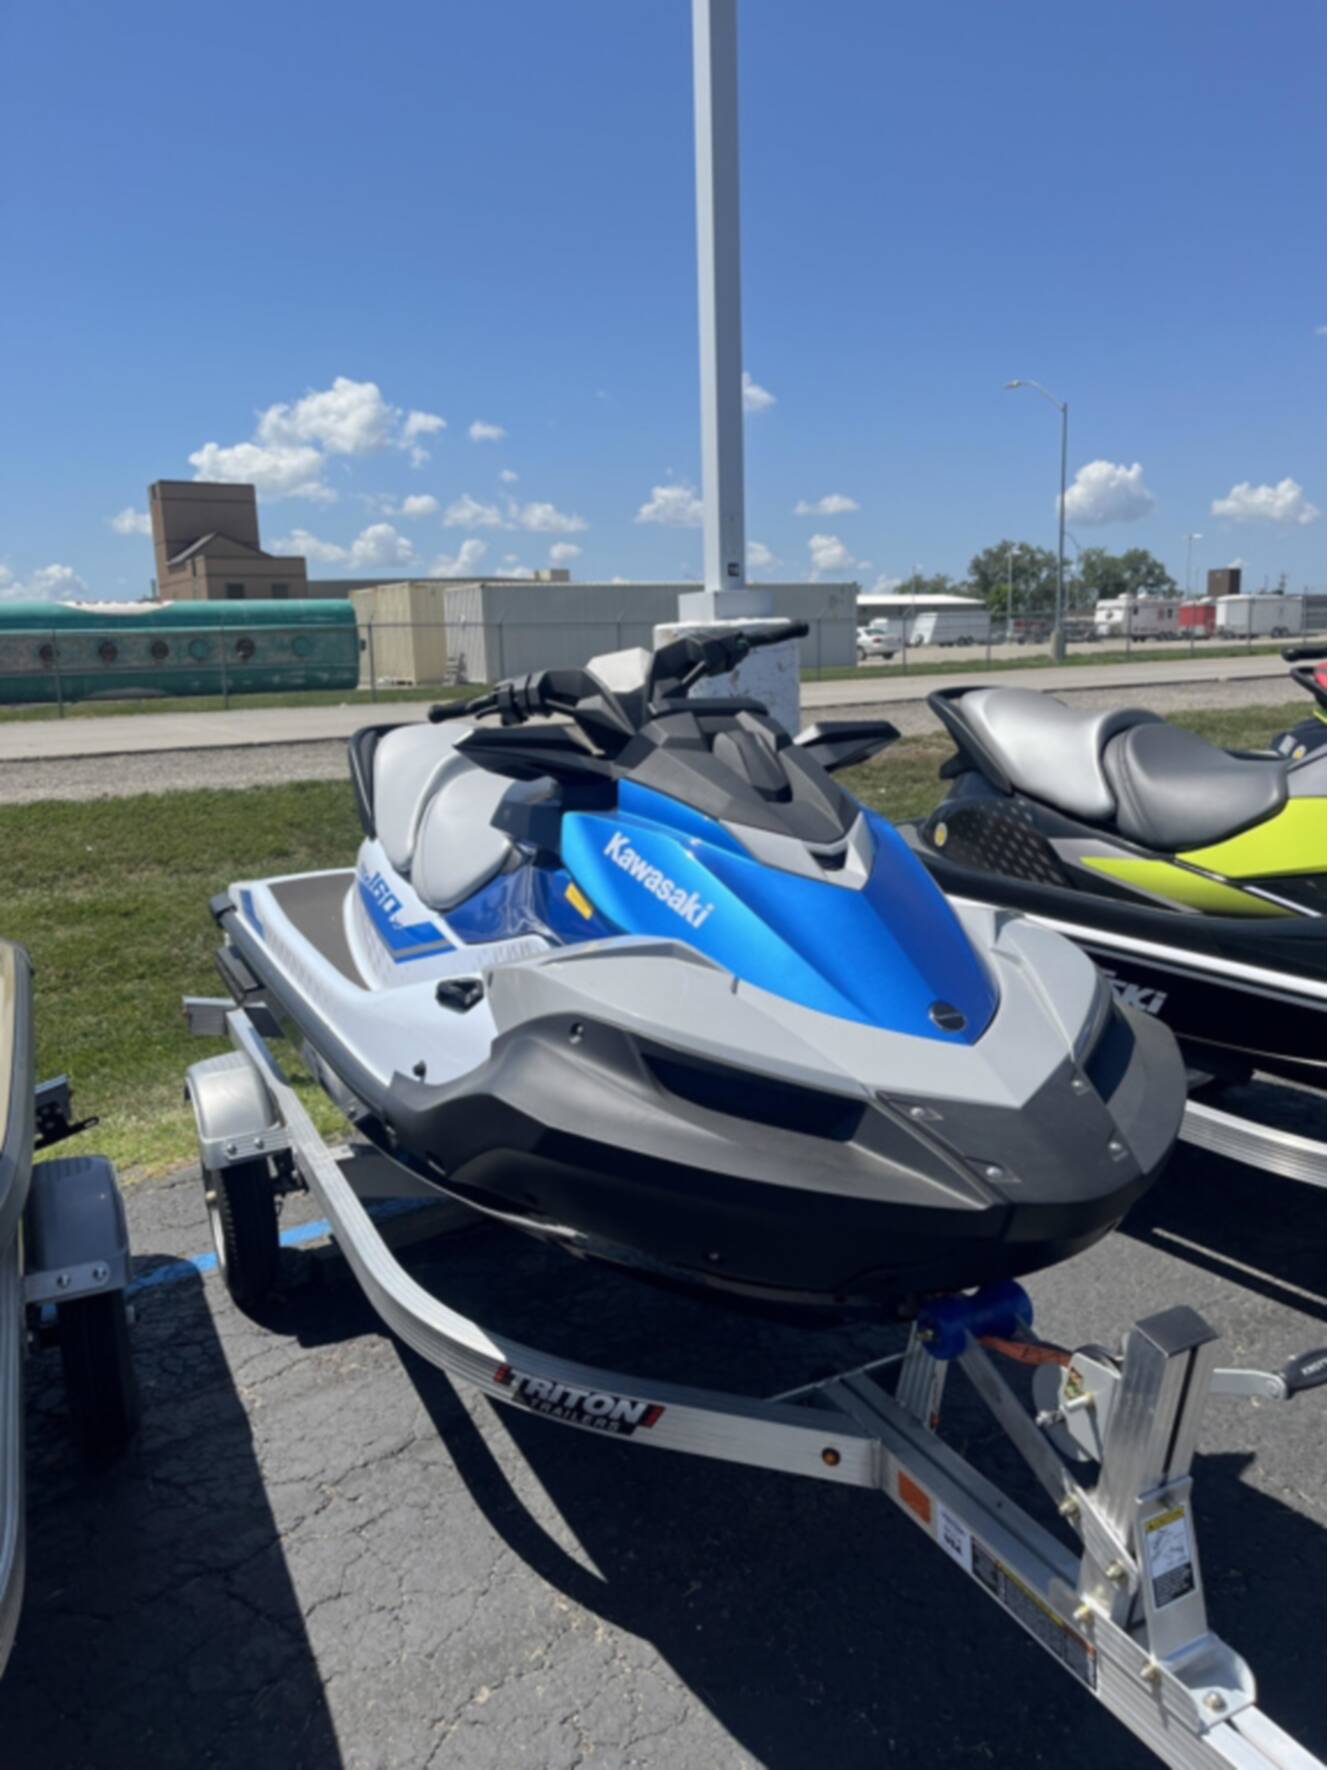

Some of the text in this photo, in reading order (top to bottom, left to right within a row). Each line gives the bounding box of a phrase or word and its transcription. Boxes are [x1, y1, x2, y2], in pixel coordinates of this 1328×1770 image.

[603, 831, 714, 927] Kawasaki
[510, 1370, 648, 1424] TRITON
[530, 1398, 620, 1432] TRAILERS
